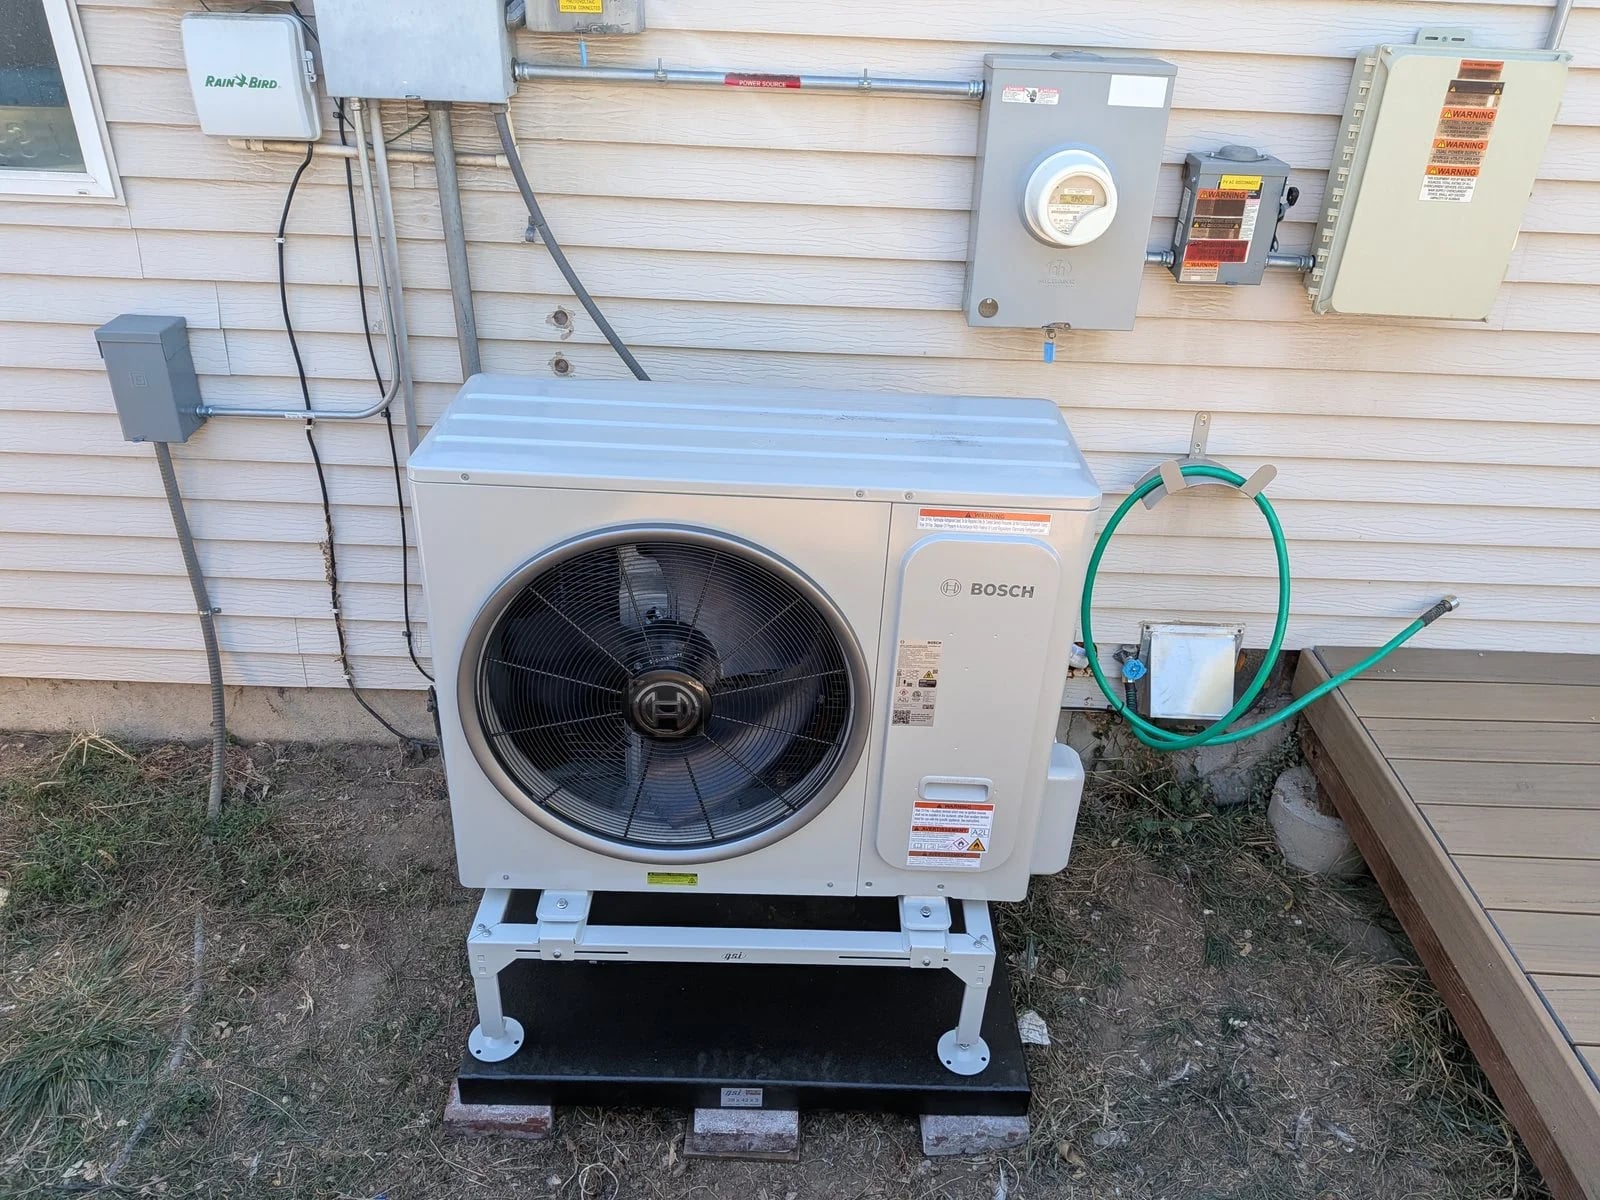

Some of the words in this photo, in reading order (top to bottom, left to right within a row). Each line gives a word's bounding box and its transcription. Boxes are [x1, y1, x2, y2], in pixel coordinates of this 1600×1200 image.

[205, 75, 235, 87] RAIN
[248, 76, 277, 89] BIRD
[1452, 110, 1494, 119] WARNING
[1446, 140, 1484, 149] WARNING
[1437, 167, 1477, 176] WARNING
[1208, 191, 1246, 199] WARNING
[974, 512, 1006, 520] WARNING
[970, 582, 1035, 598] BOSCH
